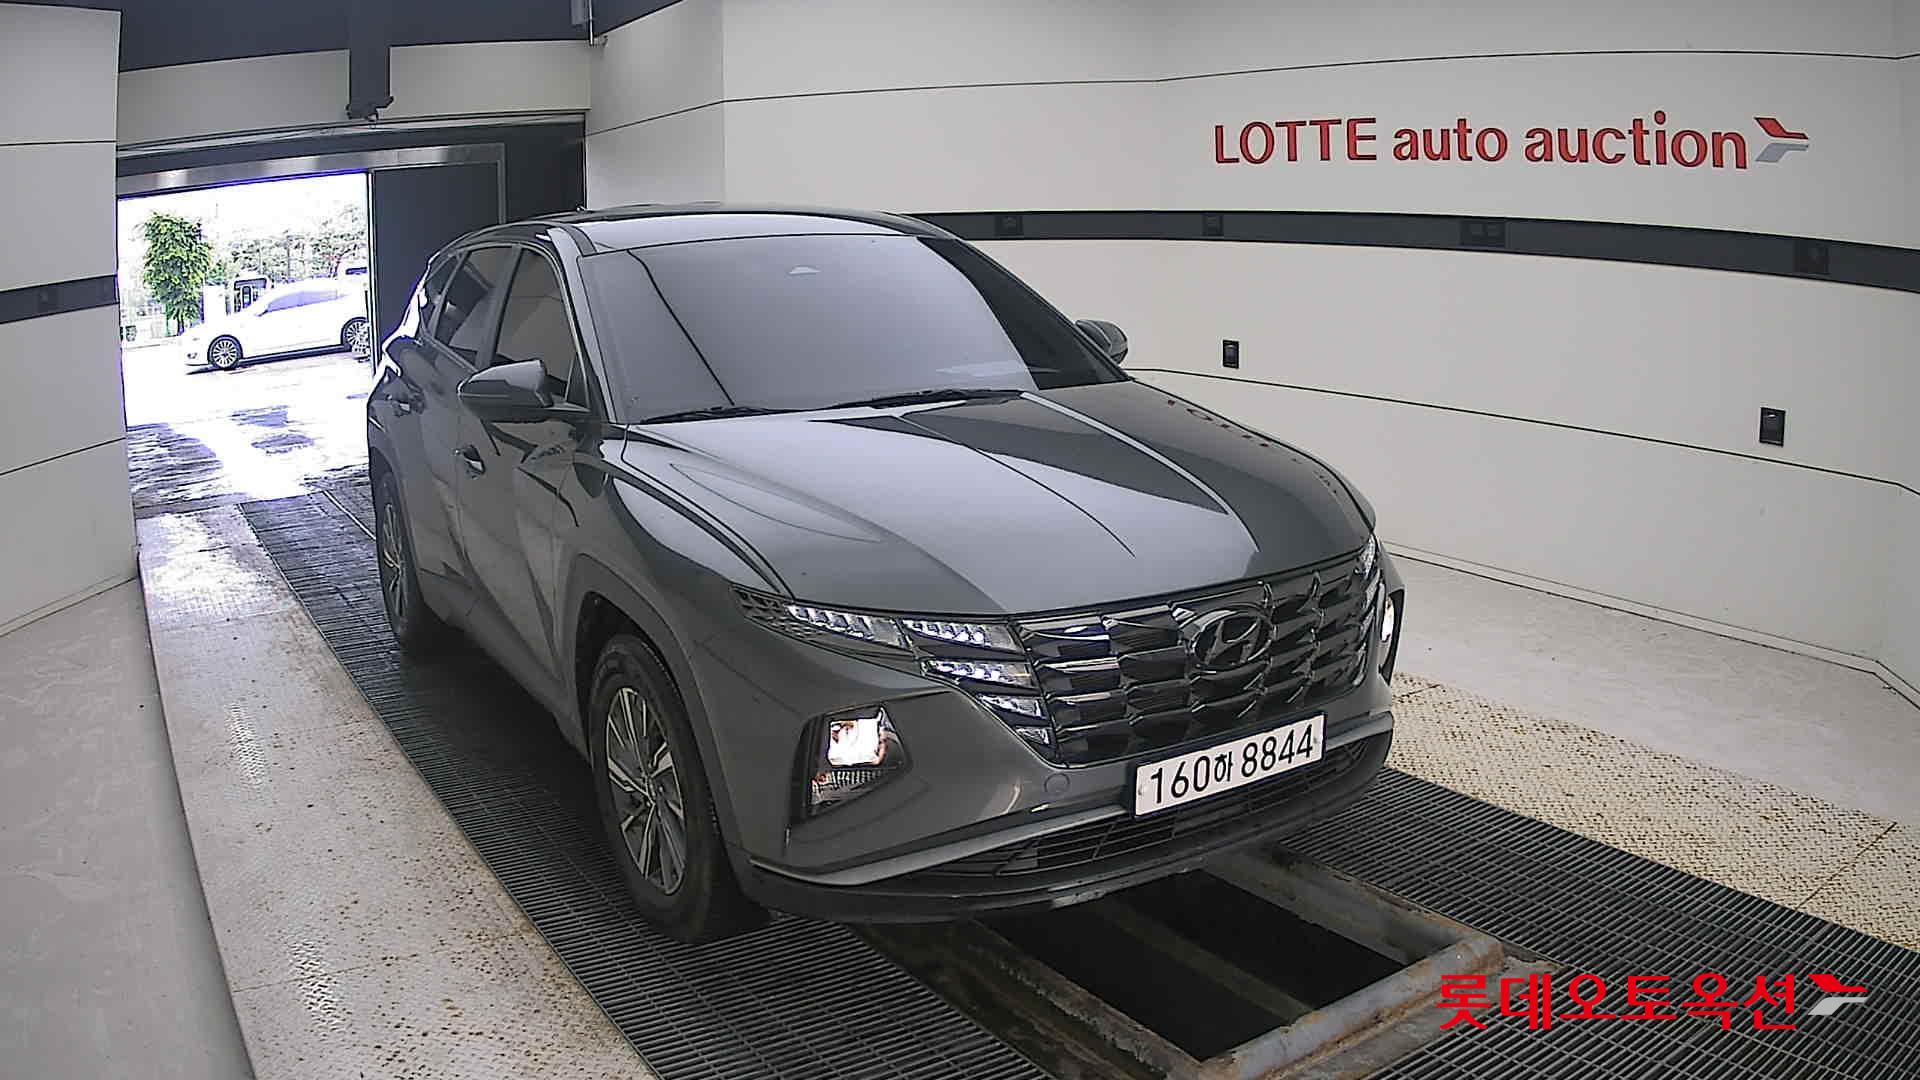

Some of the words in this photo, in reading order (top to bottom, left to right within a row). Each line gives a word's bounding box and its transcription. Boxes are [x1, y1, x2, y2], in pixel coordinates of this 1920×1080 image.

[1214, 117, 1377, 164] LOTTE
[1393, 118, 1508, 162] auto
[1524, 110, 1748, 169] auction
[1151, 751, 1233, 803] 160하
[1241, 724, 1313, 777] 8844
